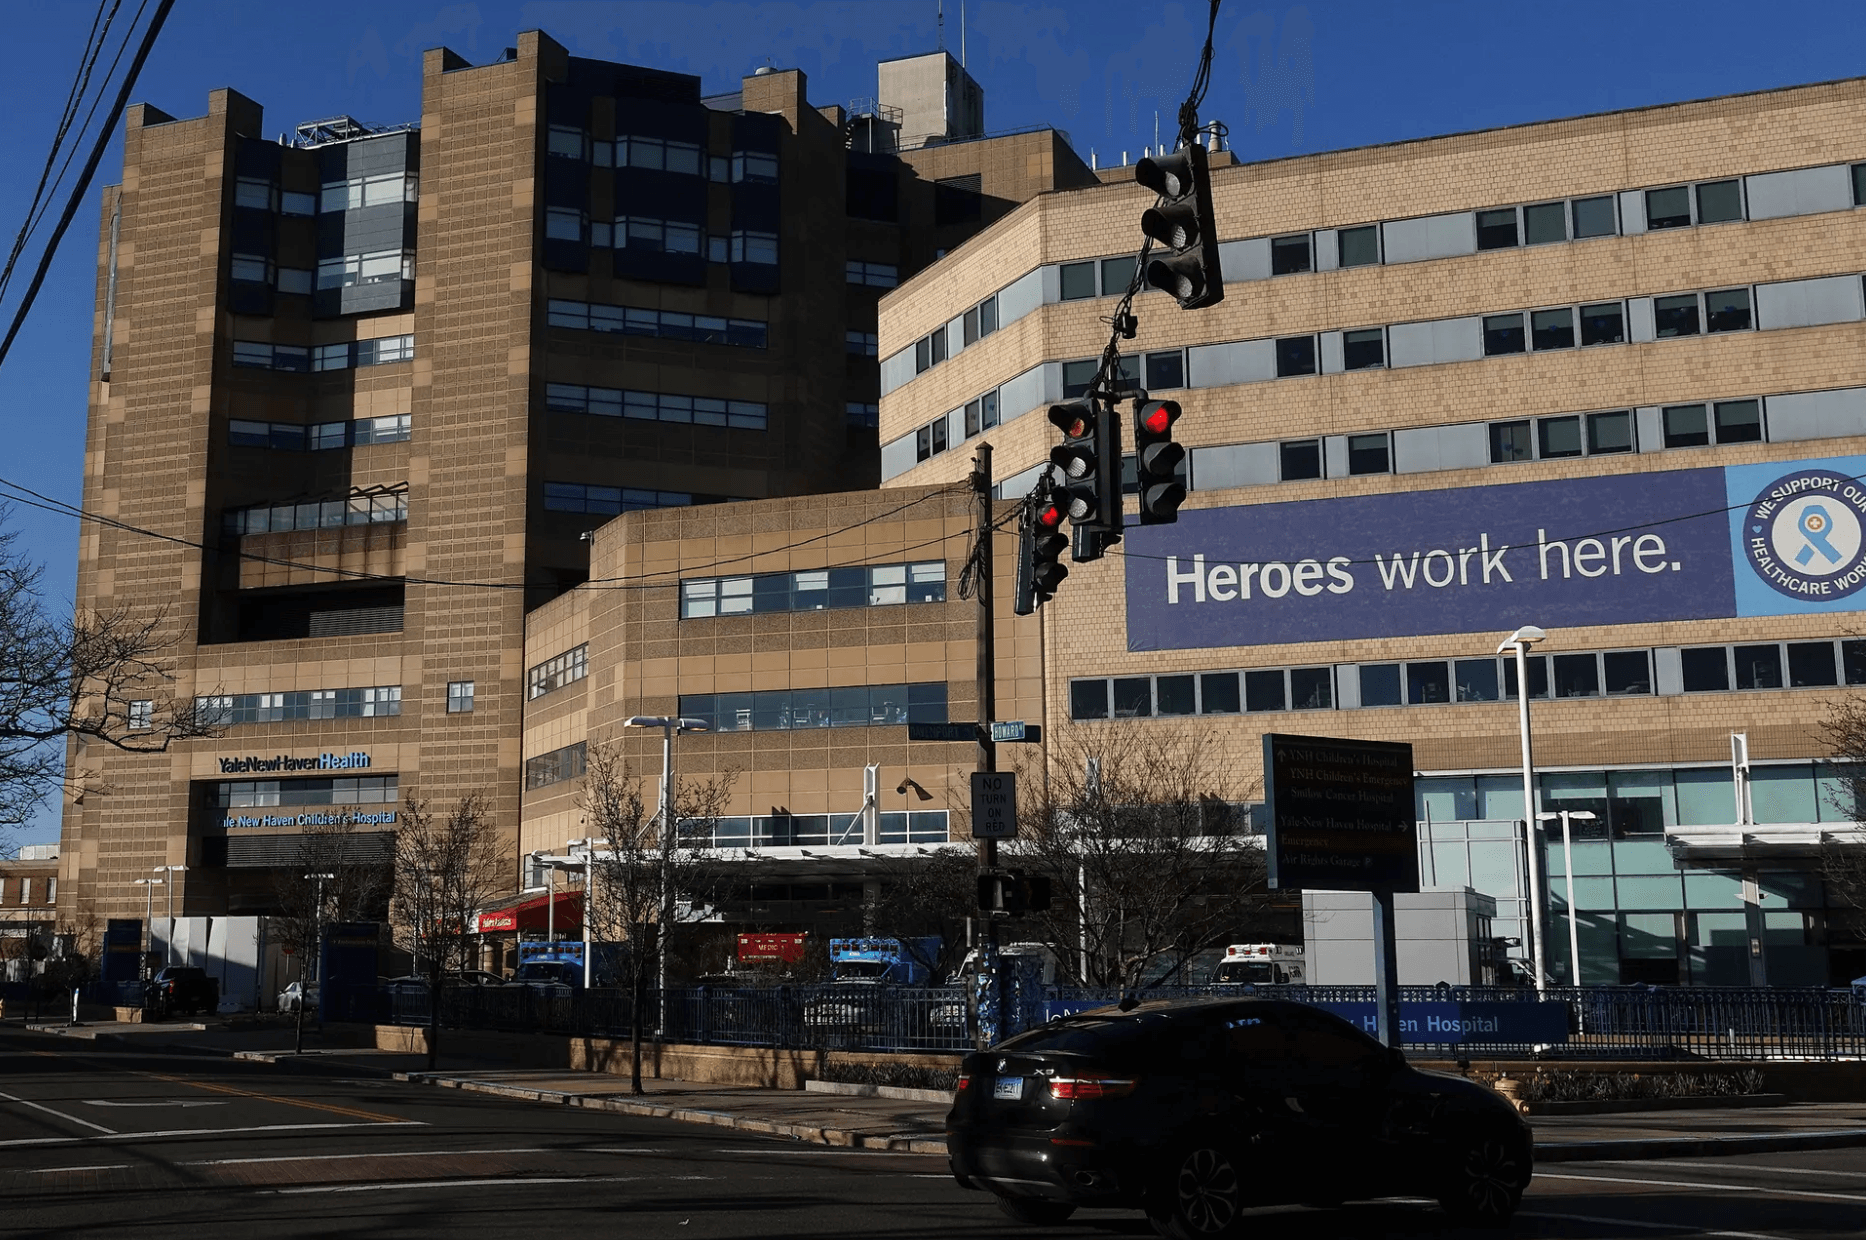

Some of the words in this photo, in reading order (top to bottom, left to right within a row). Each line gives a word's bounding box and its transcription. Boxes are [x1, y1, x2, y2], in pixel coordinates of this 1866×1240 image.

[1754, 497, 1777, 520] WE
[1771, 477, 1843, 502] SUPPORT
[1166, 553, 1354, 604] Heroes
[1374, 532, 1513, 590] work
[1538, 528, 1682, 581] here.
[1751, 537, 1832, 595] HEALTHCARE
[910, 725, 959, 739] DAVENPORT
[994, 723, 1019, 739] HOWARD
[218, 752, 370, 773] YaleNewHavenHealth
[1289, 749, 1314, 762] YNH
[1316, 751, 1360, 764] Children's
[1362, 754, 1398, 768] Hospital
[982, 777, 1002, 790] NO
[1290, 767, 1314, 780] YNH
[1316, 769, 1361, 784] Children's
[1363, 772, 1409, 787] Emergency
[980, 793, 1007, 804] TURN
[1291, 786, 1323, 798] Smilow
[1325, 789, 1356, 801] Cancer
[1358, 790, 1394, 804] Hospital
[238, 815, 261, 828] New
[263, 814, 296, 828] Haven
[298, 812, 352, 826] Children's
[352, 811, 396, 827] Hospital
[987, 808, 1002, 818] ON
[985, 822, 1005, 832] RED
[1326, 817, 1355, 830] Haven
[1357, 818, 1392, 832] Hospital
[1281, 833, 1330, 848] Emergency
[1282, 853, 1297, 865] Air
[1300, 853, 1329, 867] Rights
[1330, 854, 1362, 868] Garage
[1363, 1015, 1418, 1032] Hen
[1427, 1015, 1499, 1036] Hospital
